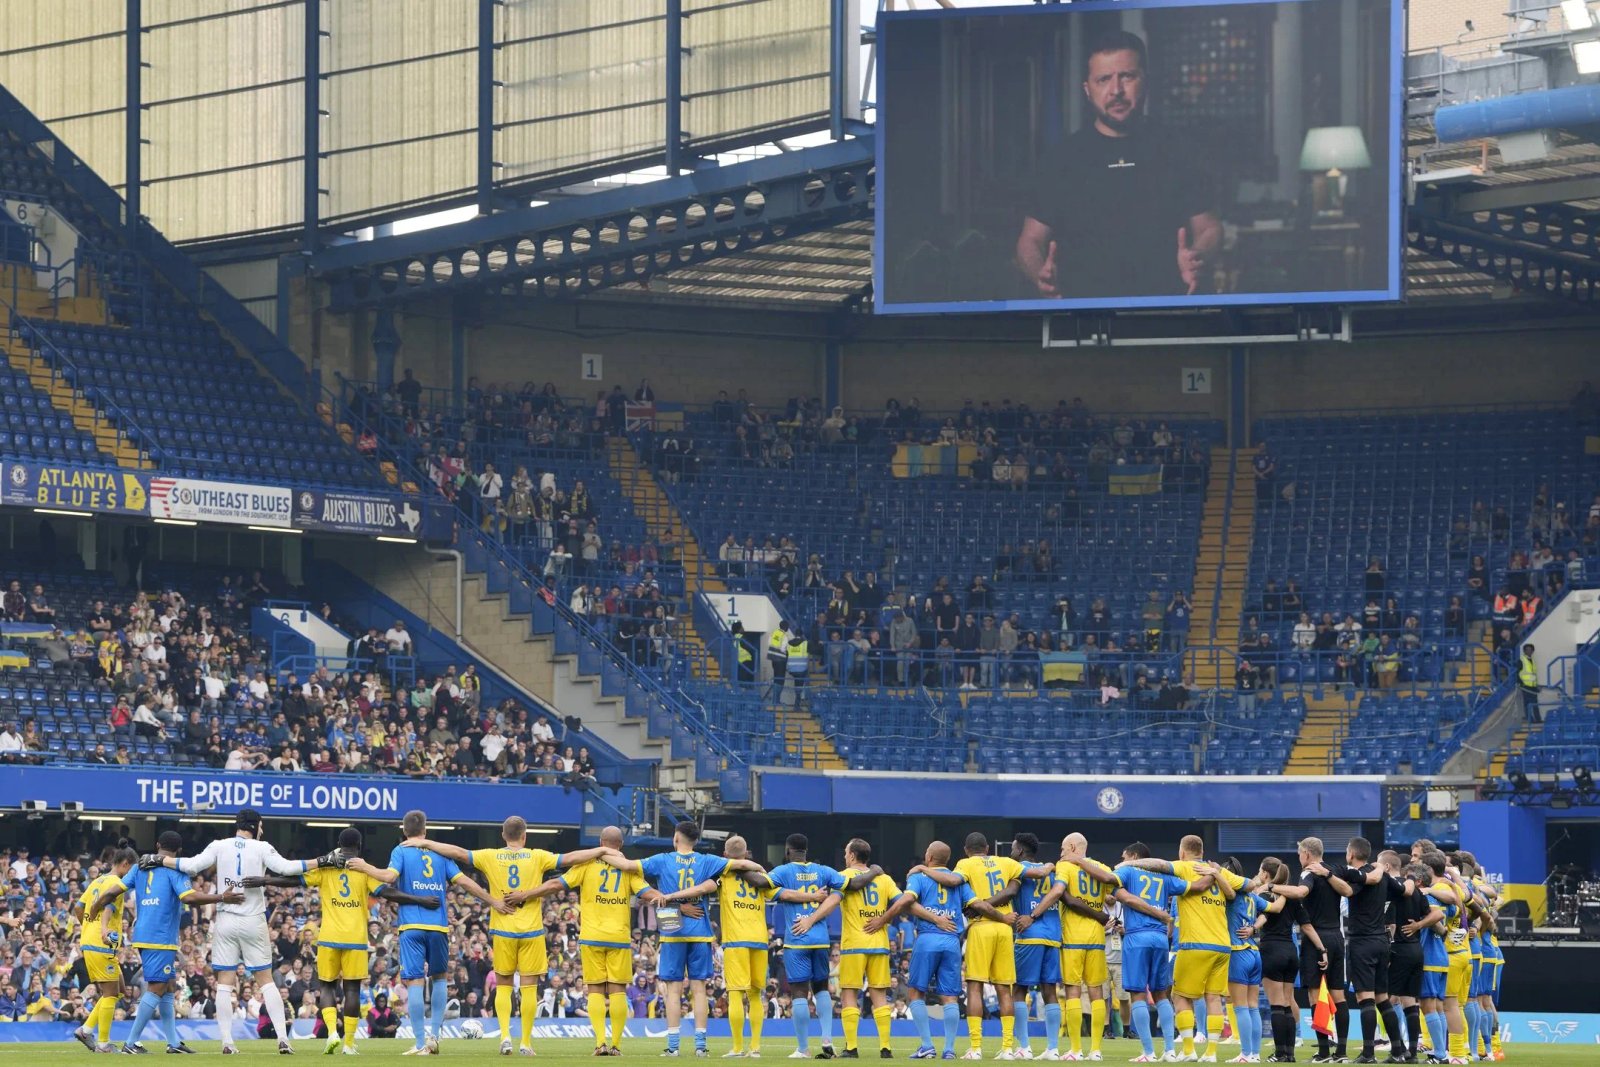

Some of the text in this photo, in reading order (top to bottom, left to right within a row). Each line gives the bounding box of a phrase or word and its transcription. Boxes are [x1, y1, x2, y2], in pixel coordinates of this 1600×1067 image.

[17, 203, 27, 220] 6
[586, 358, 597, 378] 1
[39, 468, 117, 491] ATLANTA
[37, 486, 118, 509] BLUES
[252, 494, 290, 513] BLUES
[322, 499, 361, 523] AUSTIN
[364, 502, 396, 527] BLUES
[727, 596, 739, 617] 1
[137, 778, 398, 811] THE PRIDE OF LONDON
[236, 852, 242, 876] 1
[422, 854, 435, 879] 3
[339, 873, 351, 898] 3
[508, 864, 520, 889] 8
[599, 868, 622, 893] 27
[677, 868, 695, 891] 16
[985, 869, 1005, 897] 15
[1078, 869, 1101, 898] 60
[1139, 875, 1164, 901] 27
[595, 895, 627, 905] Revolut
